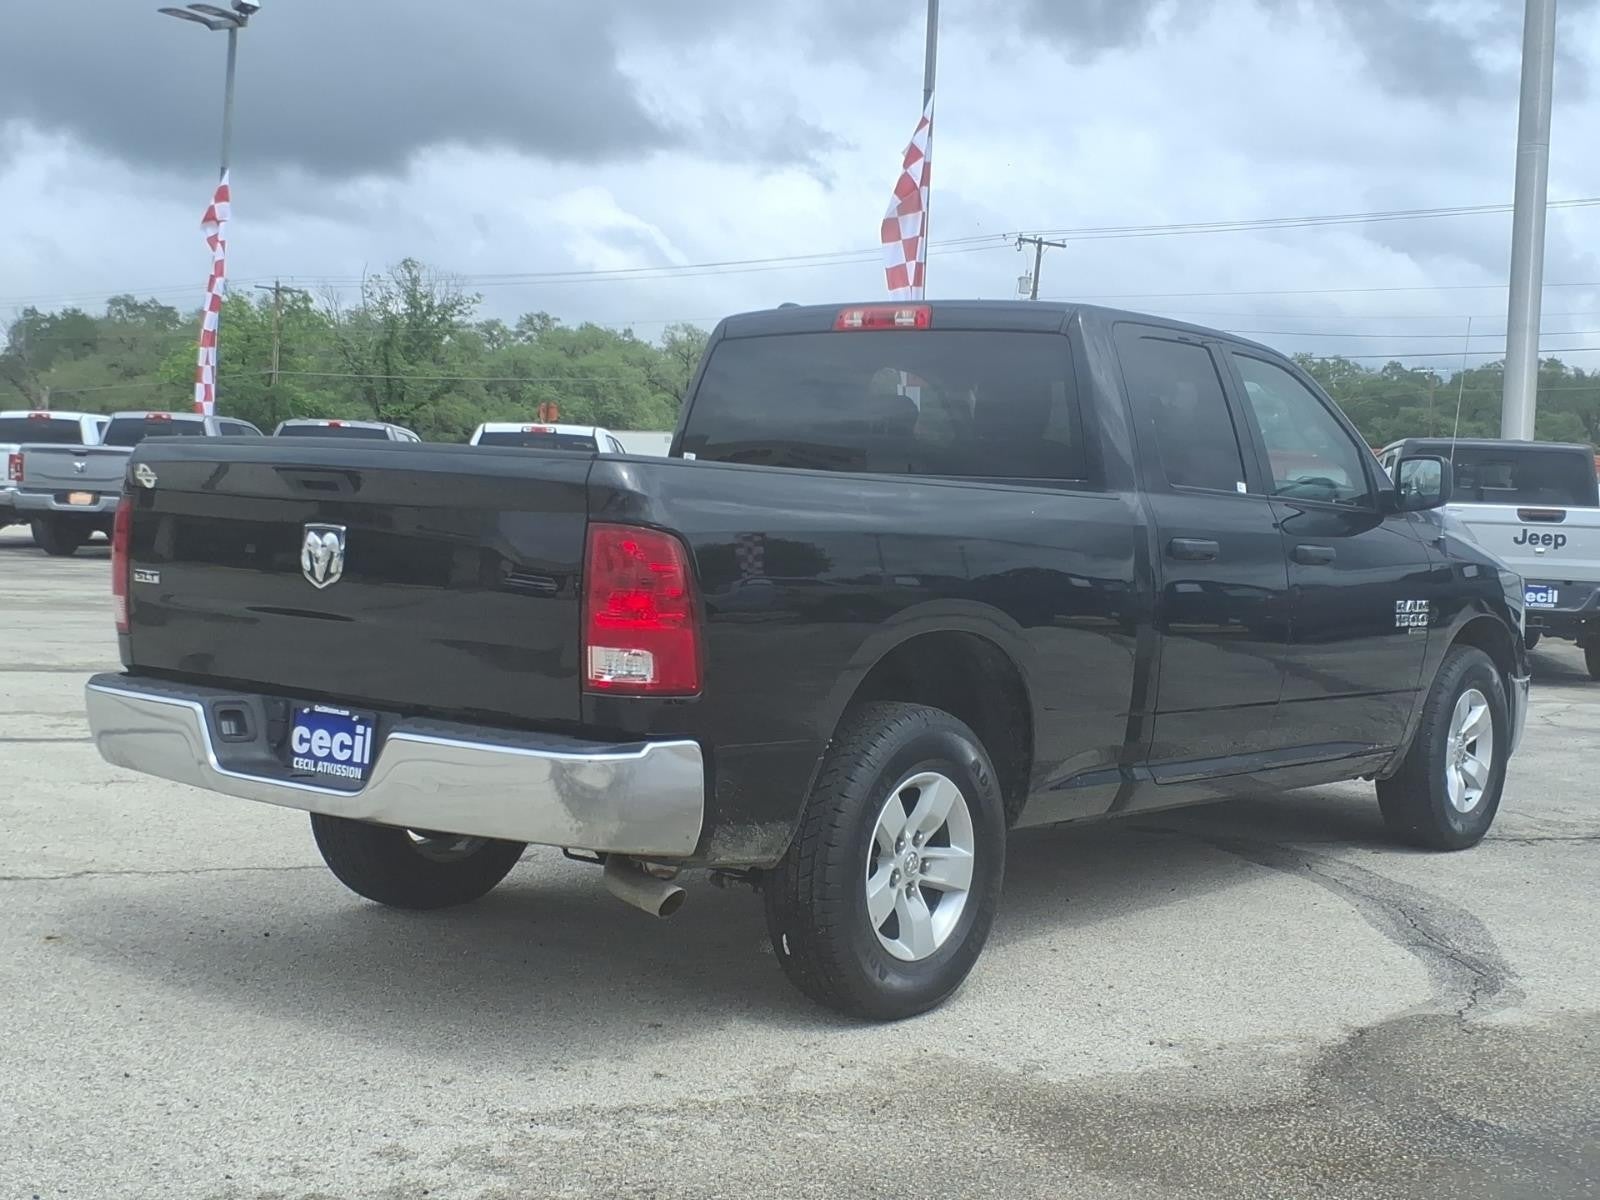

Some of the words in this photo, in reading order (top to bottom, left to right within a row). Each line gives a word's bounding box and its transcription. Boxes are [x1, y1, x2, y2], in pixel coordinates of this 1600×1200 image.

[1513, 528, 1567, 550] Jeep
[1525, 589, 1559, 603] ecil
[1396, 600, 1429, 613] RAM
[1395, 613, 1429, 627] 1500
[291, 725, 372, 764] cecil
[293, 757, 316, 772] CECIL
[316, 761, 362, 779] ATKISSION
